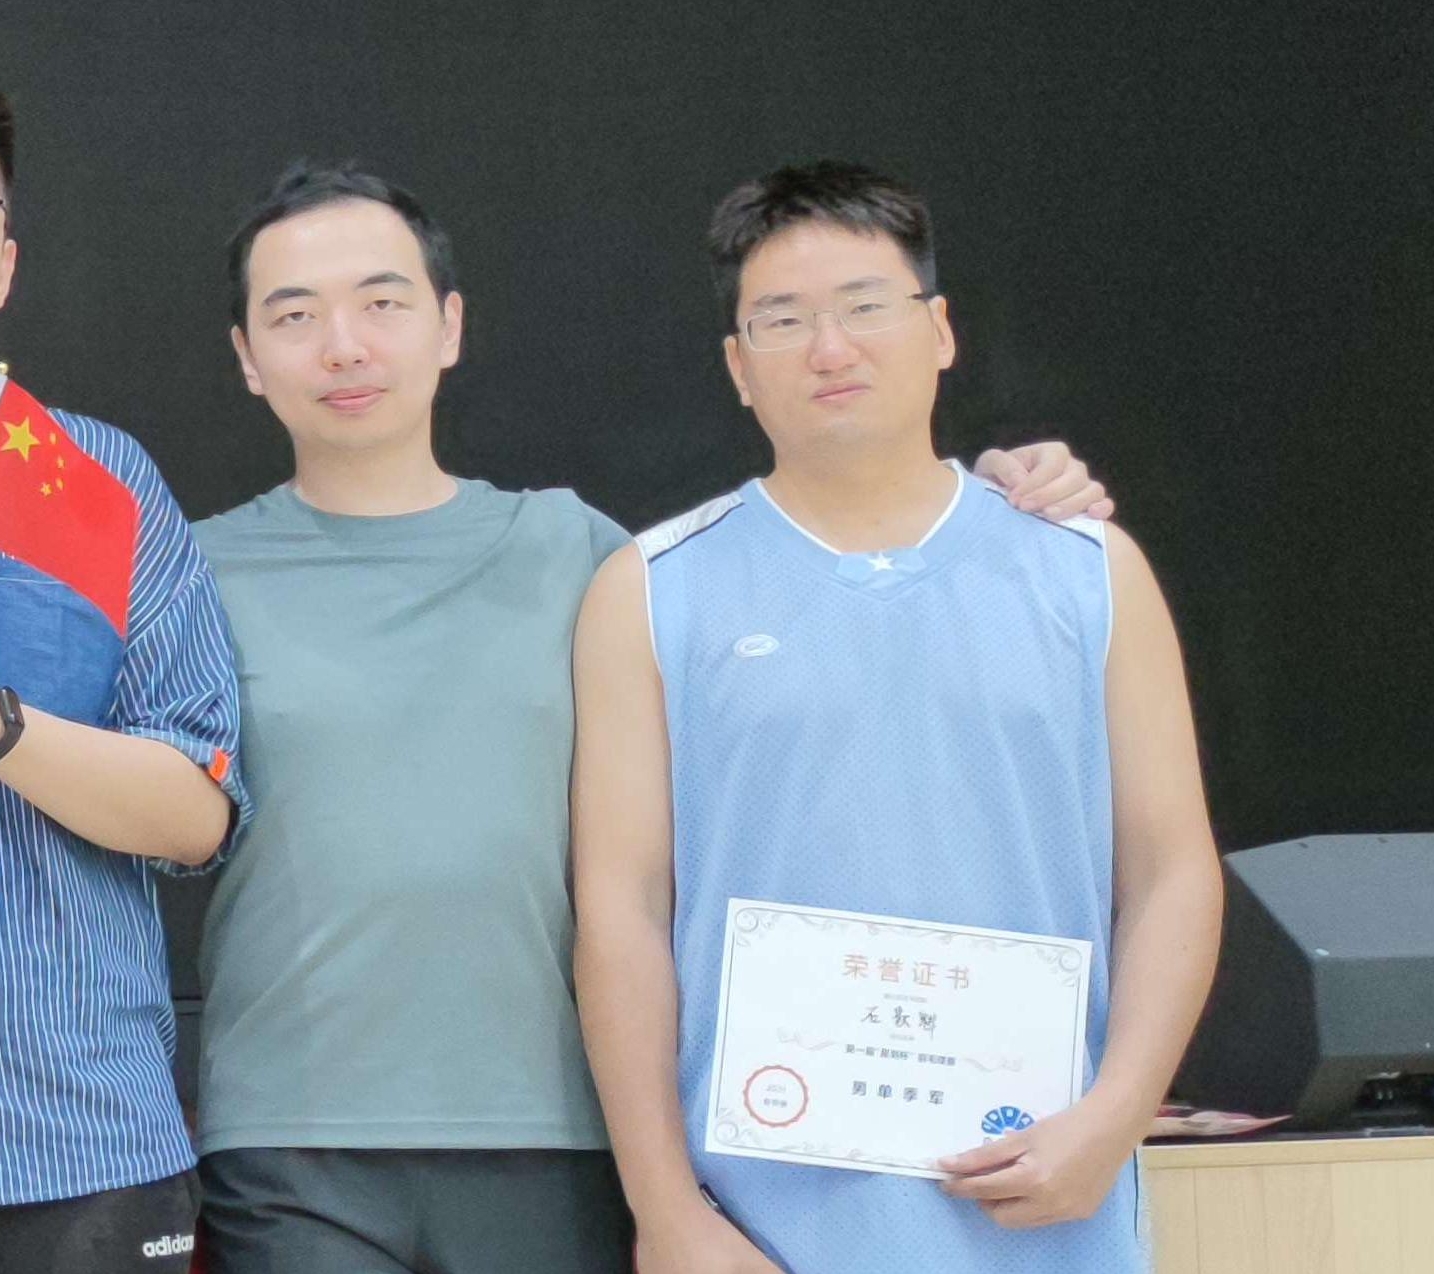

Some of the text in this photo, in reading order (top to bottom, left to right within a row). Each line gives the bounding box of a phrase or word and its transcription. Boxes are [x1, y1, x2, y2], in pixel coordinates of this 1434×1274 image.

[842, 954, 970, 989] 荣誉证书
[851, 1080, 944, 1105] 男单季军
